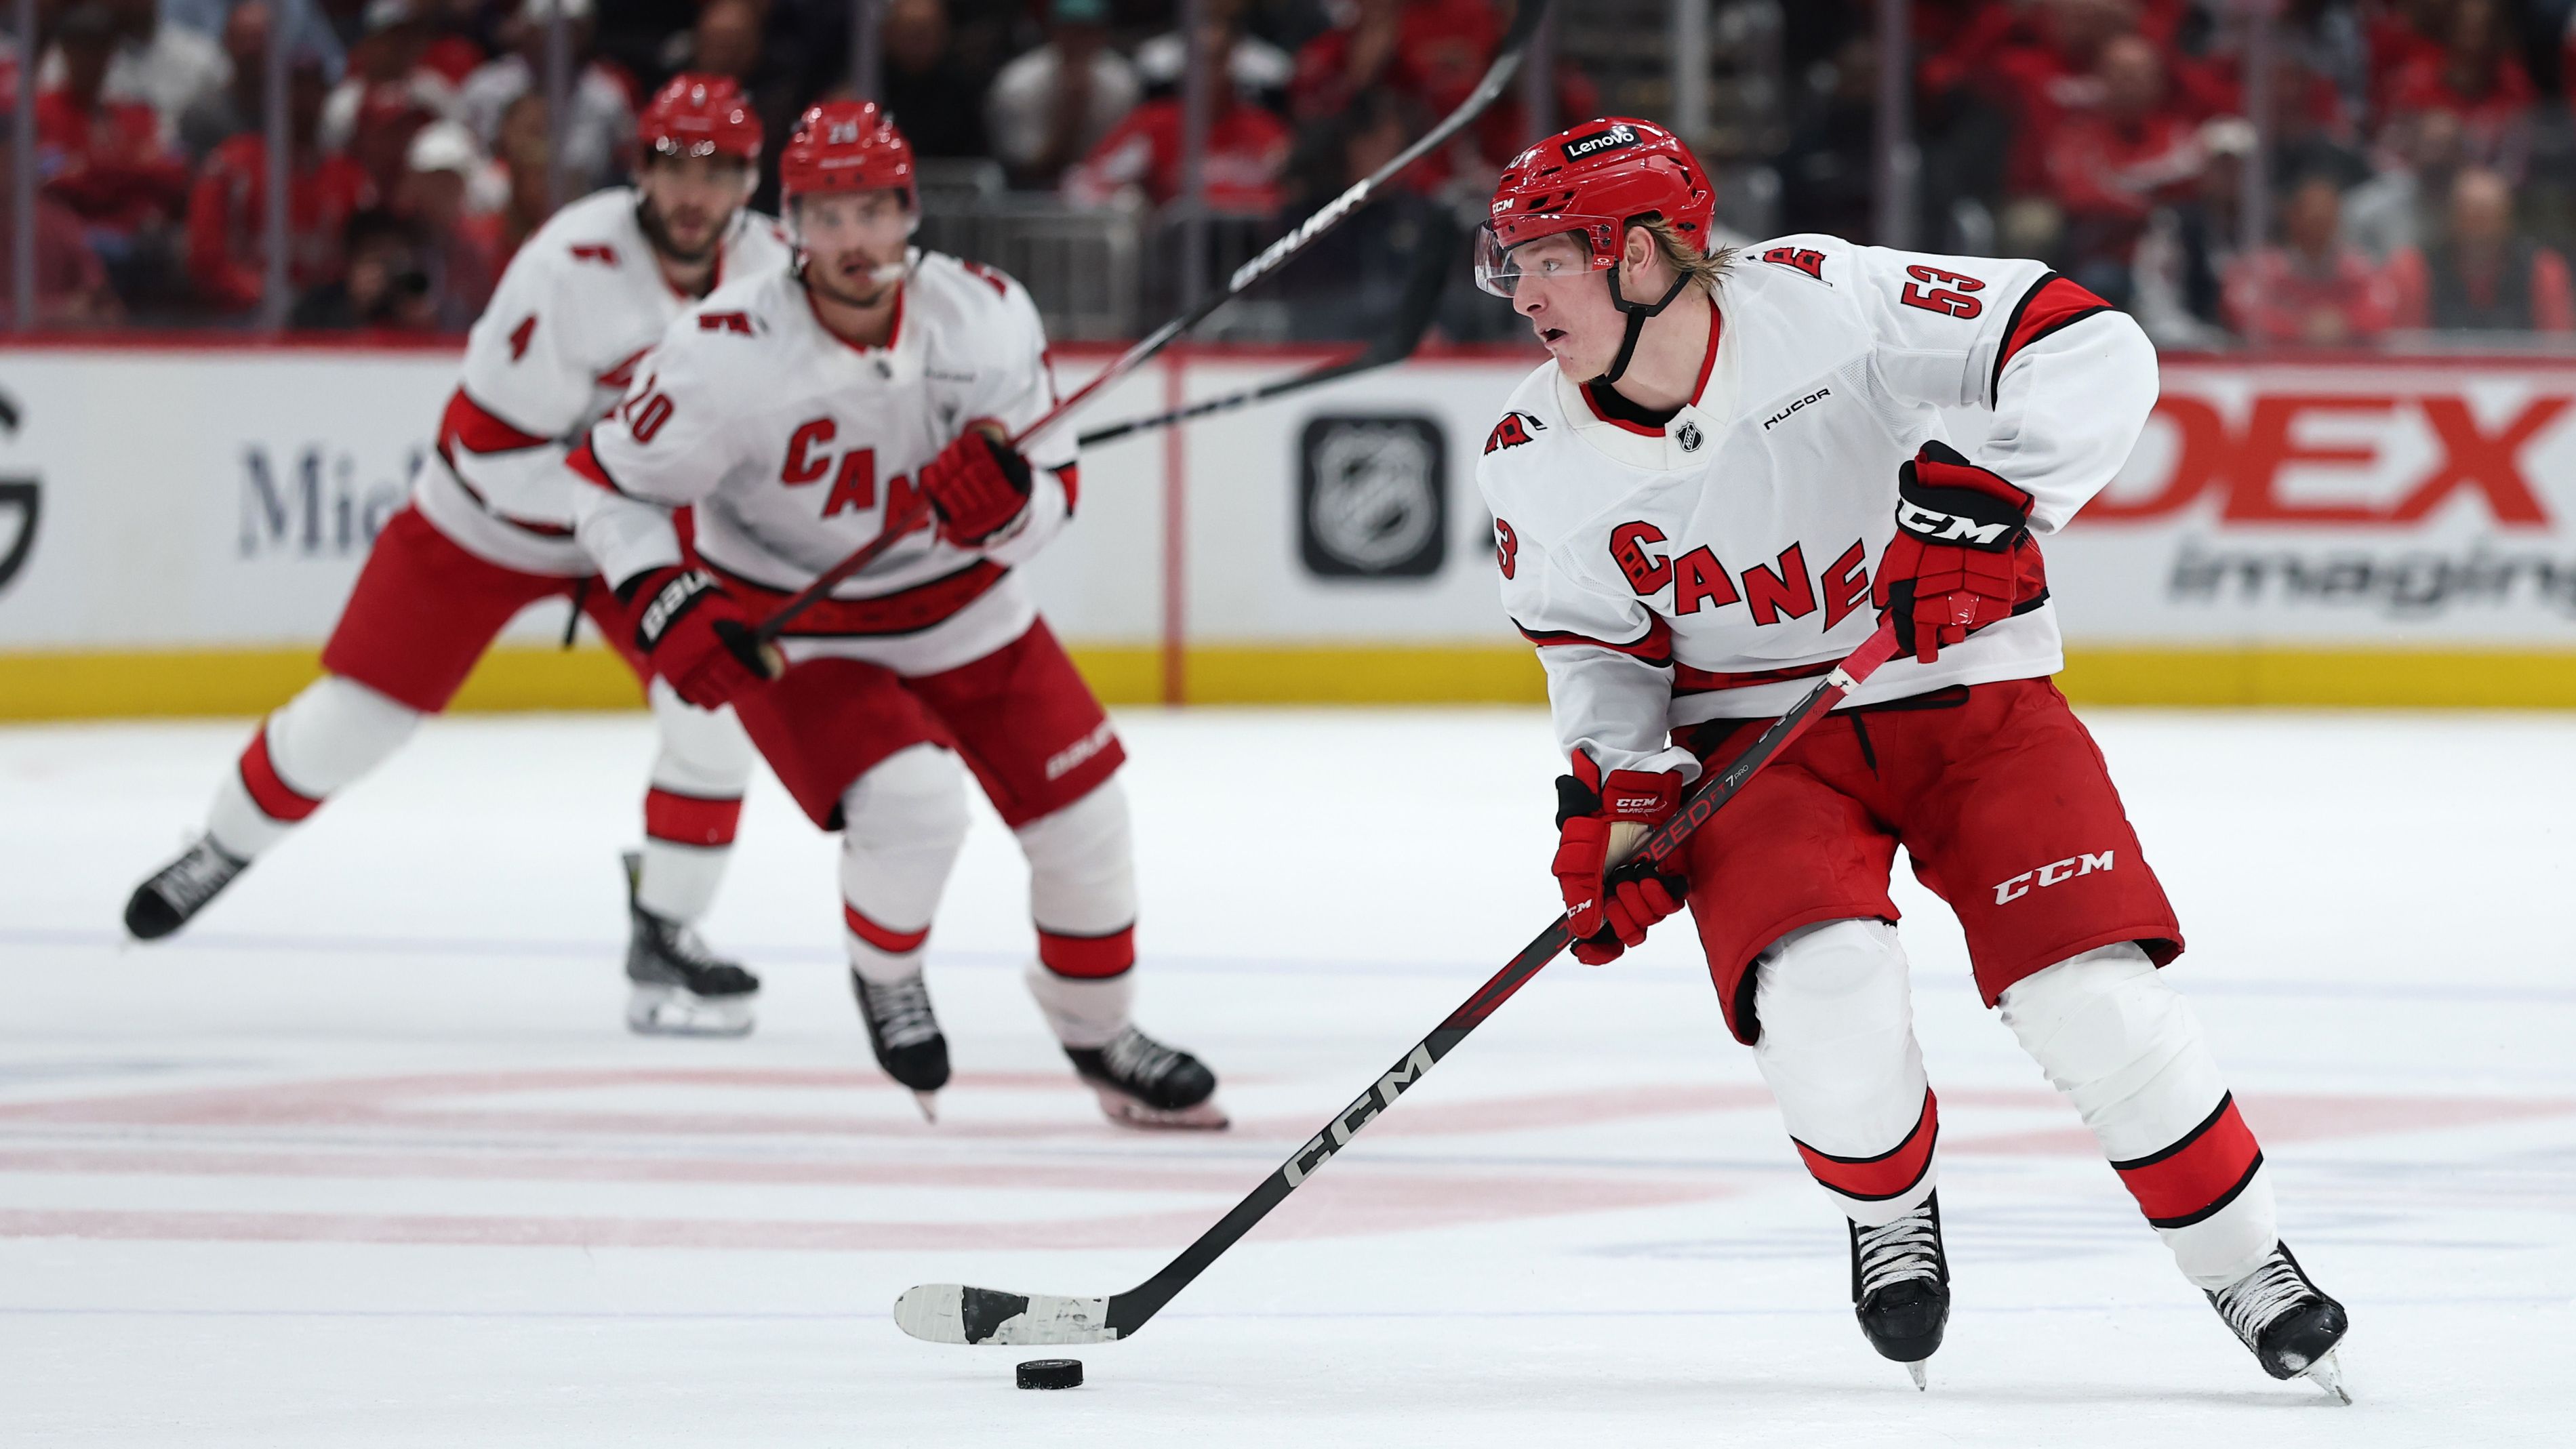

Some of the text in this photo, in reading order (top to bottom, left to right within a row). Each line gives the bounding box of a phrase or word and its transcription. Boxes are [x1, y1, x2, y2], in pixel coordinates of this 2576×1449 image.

[1568, 132, 1634, 157] Lenovo
[1900, 265, 1986, 319] 53
[1764, 388, 1831, 430] NUCOR
[1898, 497, 2011, 544] CM
[1609, 521, 1896, 634] CANE
[1616, 796, 1658, 807] CCM
[1992, 850, 2114, 905] CCM
[1283, 1041, 1434, 1188] CCM
